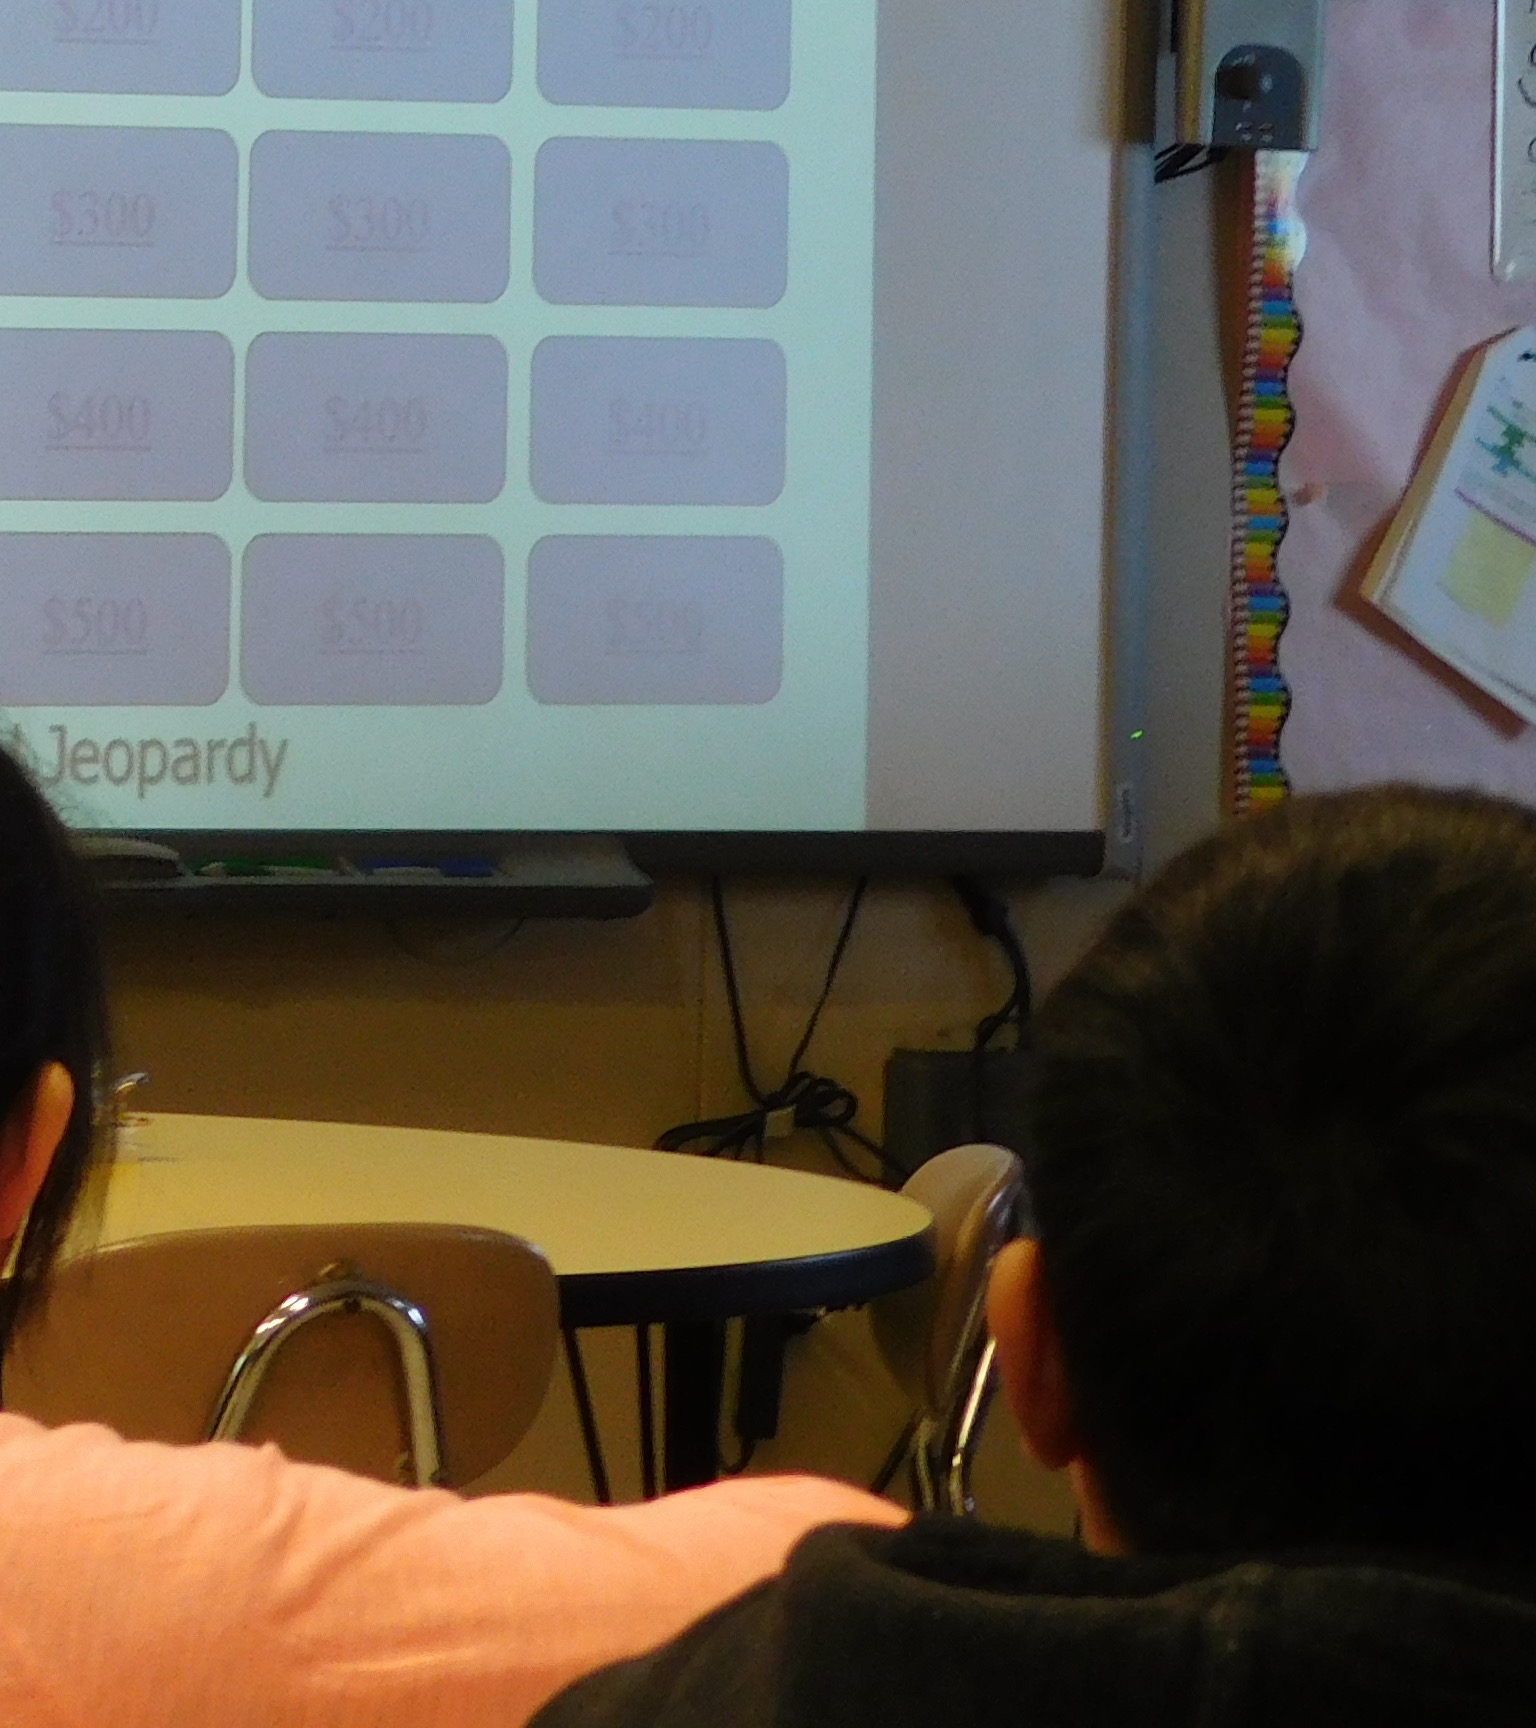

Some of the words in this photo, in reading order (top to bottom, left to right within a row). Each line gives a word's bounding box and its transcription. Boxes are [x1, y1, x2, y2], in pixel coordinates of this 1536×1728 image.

[49, 190, 157, 247] $300
[43, 393, 152, 452] $400
[42, 597, 147, 655] $500
[36, 720, 289, 799] Jeopardy
